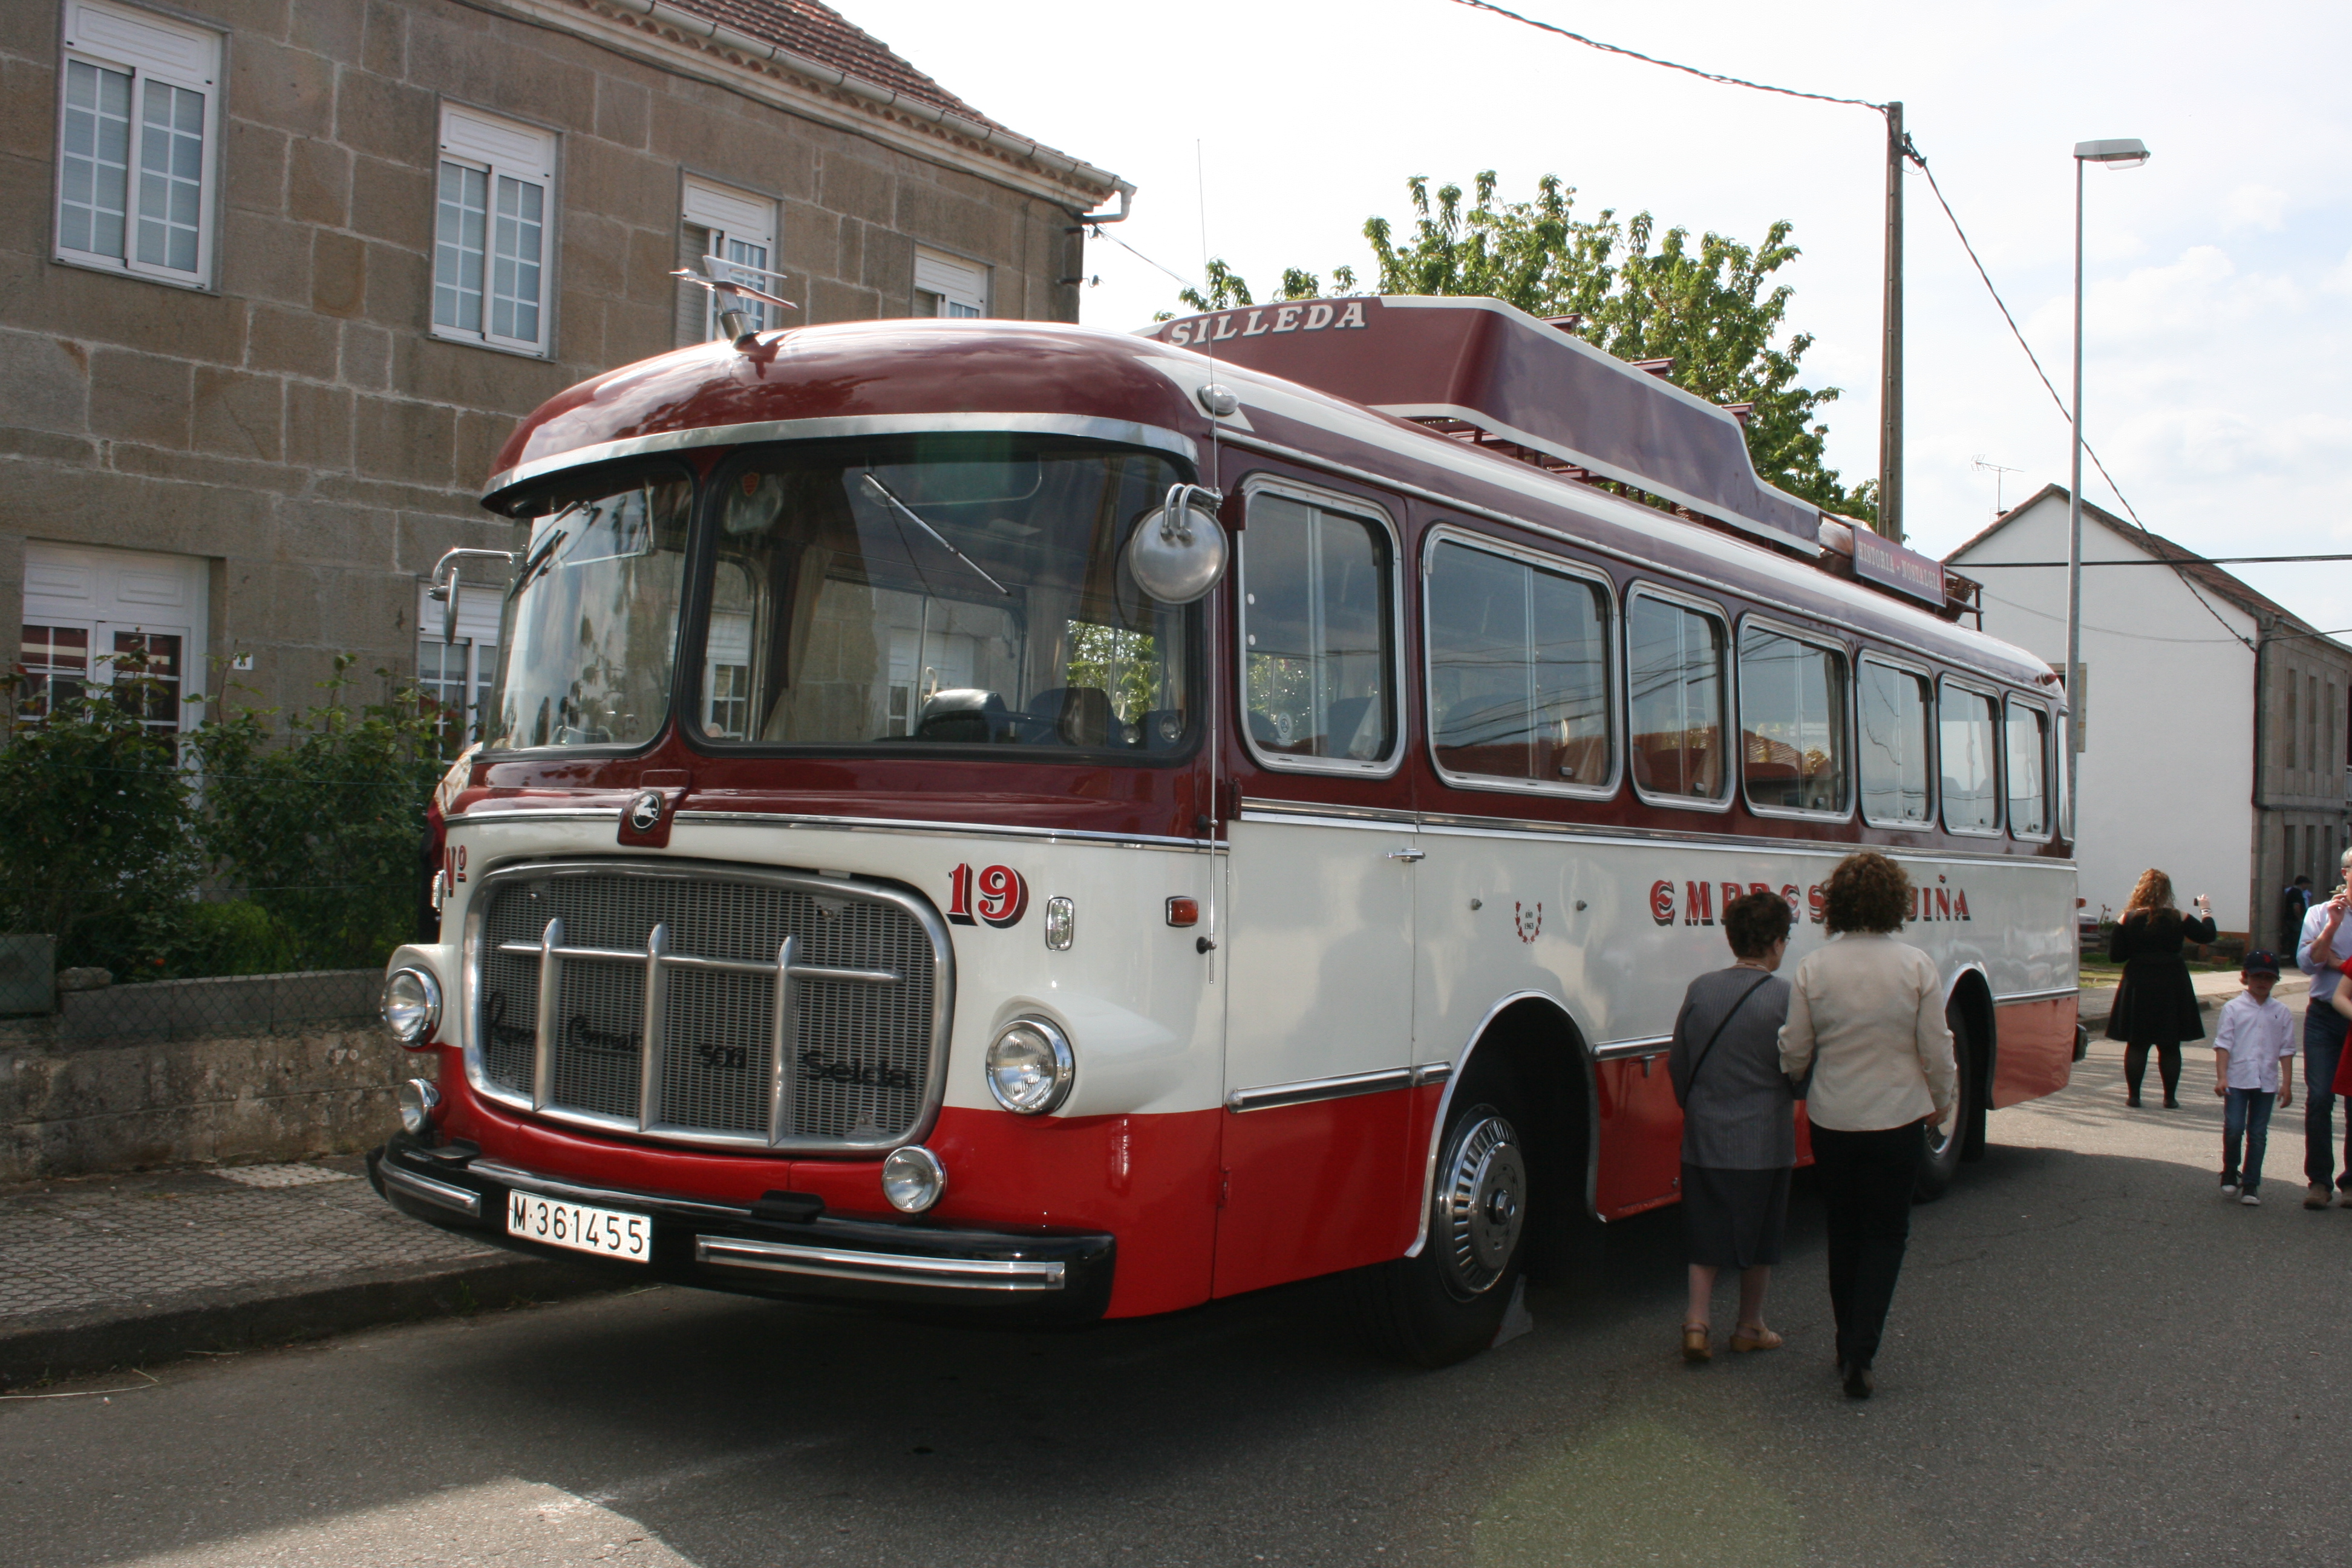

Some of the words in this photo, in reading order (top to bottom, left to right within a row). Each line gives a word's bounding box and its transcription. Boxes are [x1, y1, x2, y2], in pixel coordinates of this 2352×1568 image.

[1168, 302, 1367, 347] SILLEDA
[1857, 540, 1895, 573] HISTORIA
[1901, 559, 1941, 592] NOSTALGIA
[946, 863, 1028, 929] 19
